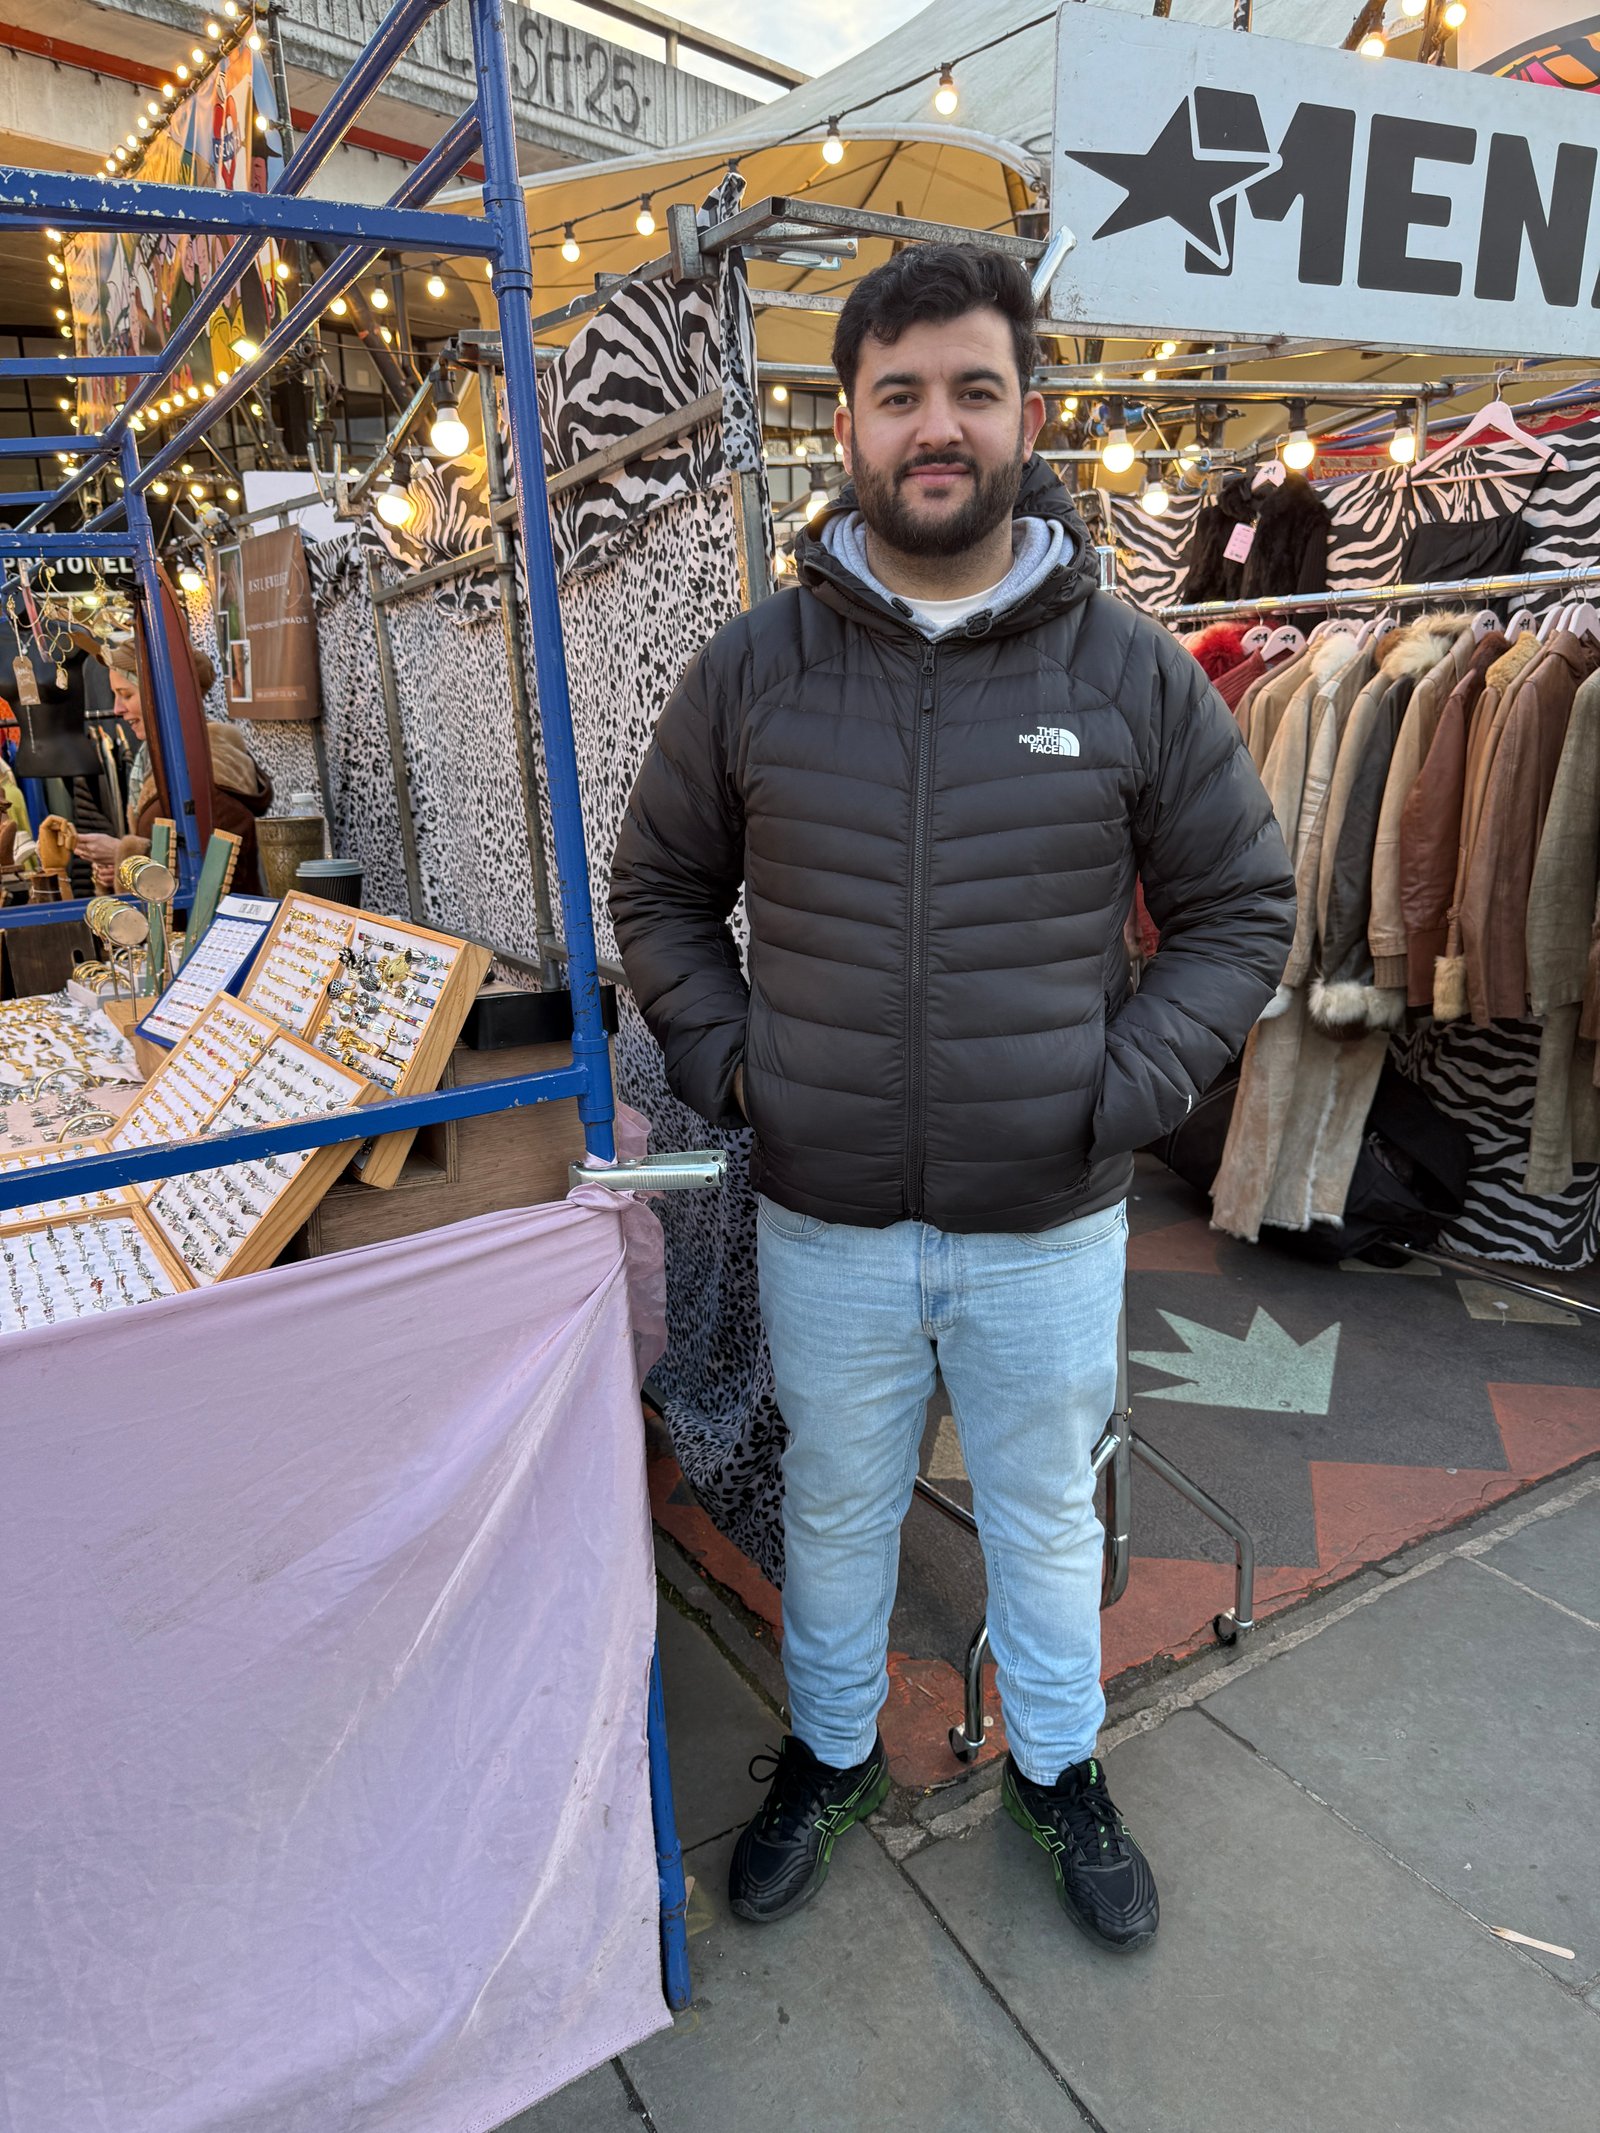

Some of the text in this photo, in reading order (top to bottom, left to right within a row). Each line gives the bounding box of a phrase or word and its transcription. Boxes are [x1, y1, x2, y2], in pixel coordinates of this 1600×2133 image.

[1184, 86, 1600, 308] MEN
[1036, 726, 1059, 737] THE
[1018, 734, 1059, 745] NORTH
[1030, 744, 1059, 755] FACE
